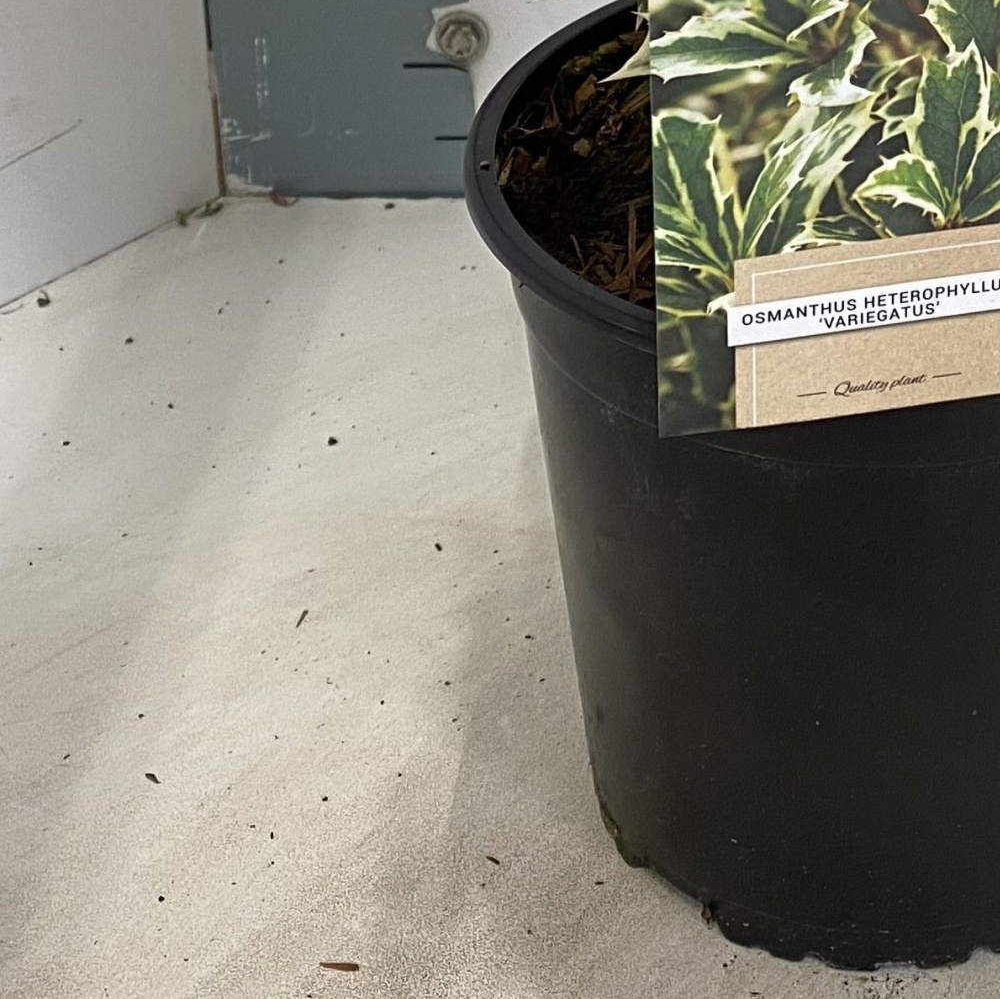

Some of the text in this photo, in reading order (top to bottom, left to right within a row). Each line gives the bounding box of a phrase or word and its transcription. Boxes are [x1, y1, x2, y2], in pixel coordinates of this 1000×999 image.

[741, 298, 857, 326] OSMANTHUS
[833, 373, 927, 397] Quality plant
